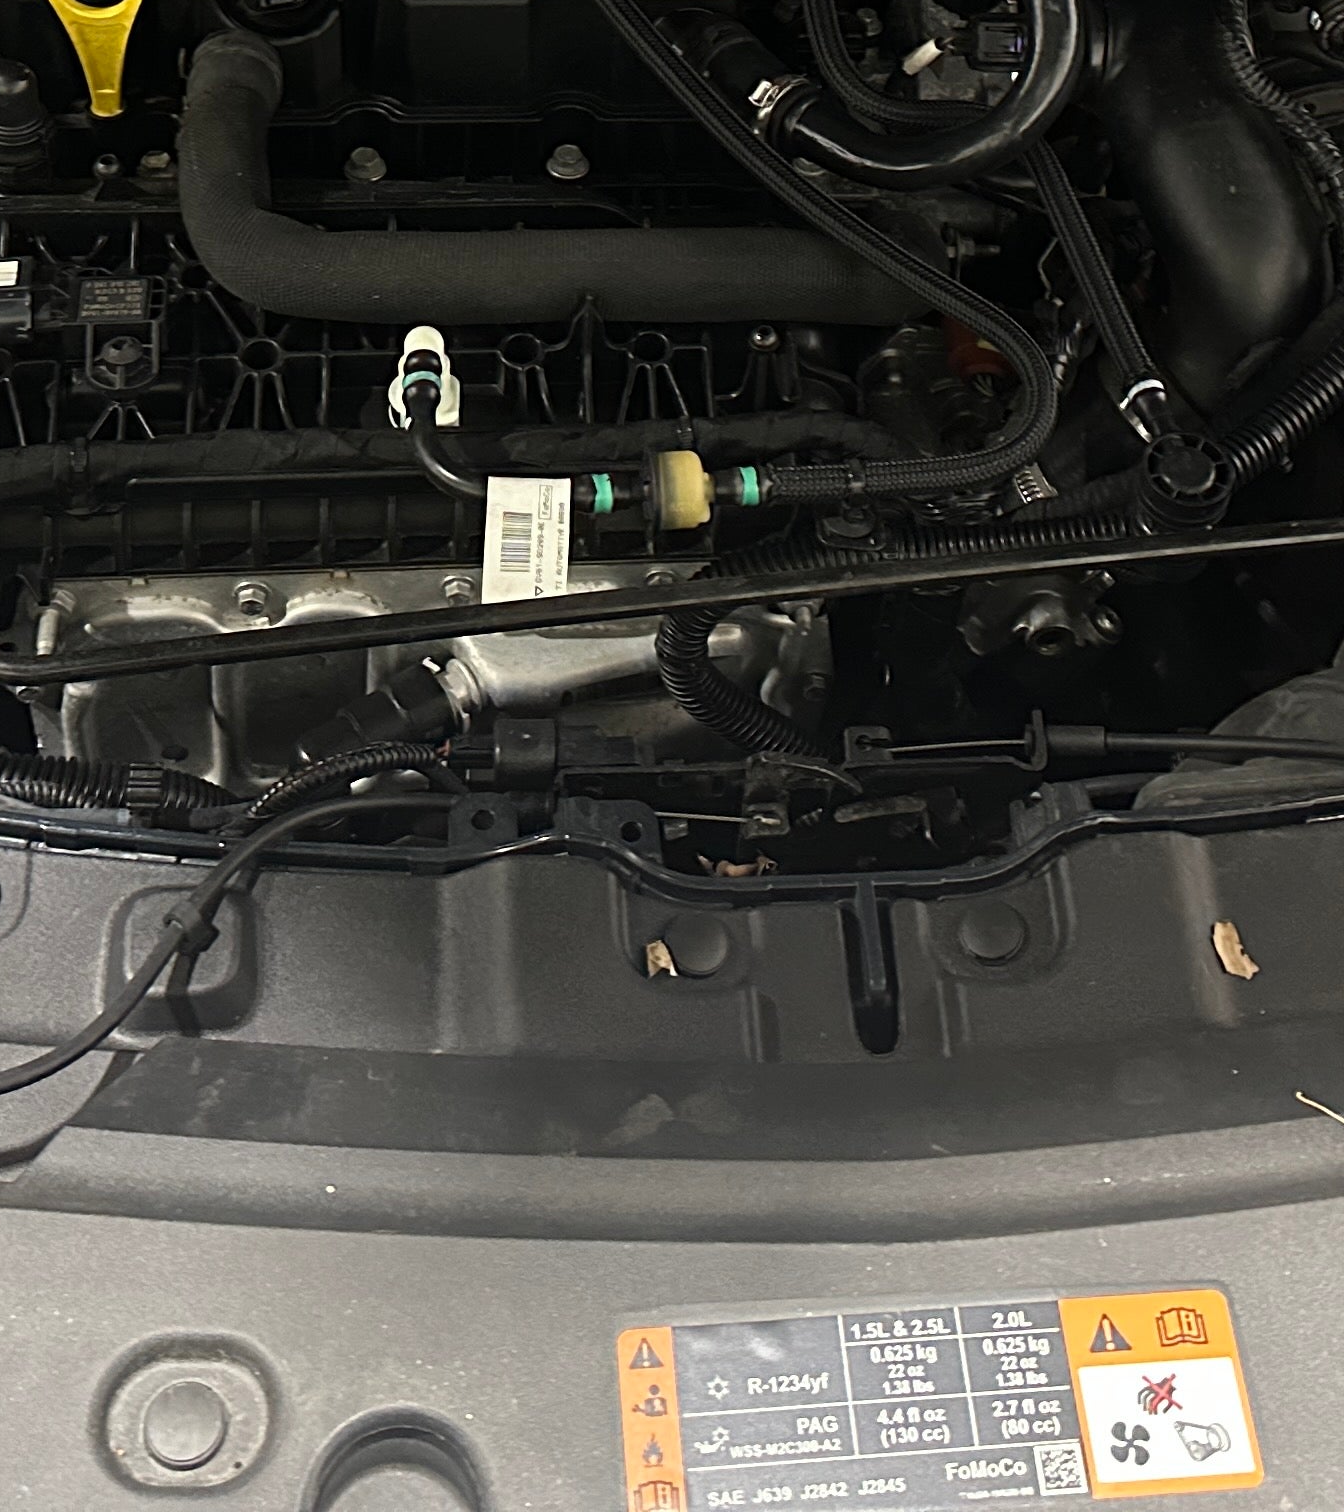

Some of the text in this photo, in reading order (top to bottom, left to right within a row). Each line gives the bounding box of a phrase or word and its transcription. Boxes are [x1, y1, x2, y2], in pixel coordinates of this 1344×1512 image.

[557, 528, 565, 575] AUTOMOTIVE
[851, 1318, 951, 1339] 1.5L & 2.5L
[992, 1311, 1032, 1328] 2.0L
[870, 1344, 937, 1363] 0.625 kg
[982, 1337, 1050, 1355] 0.625 kg
[888, 1365, 925, 1379] 22 oz
[1001, 1357, 1038, 1370] 22 oz
[747, 1372, 829, 1394] R-1234yf
[883, 1379, 935, 1395] 1.38 lbs
[996, 1372, 1048, 1386] 1.38 lbs
[877, 1407, 946, 1424] 4.4 fl oz
[992, 1399, 1061, 1417] 2.7 fl oz
[797, 1415, 838, 1434] PAG
[1002, 1416, 1061, 1438] (80 cc)
[880, 1425, 950, 1448] (130 cc)
[946, 1458, 1027, 1480] FoMoCo
[708, 1478, 906, 1507] SAE J639 J2842 J2845
